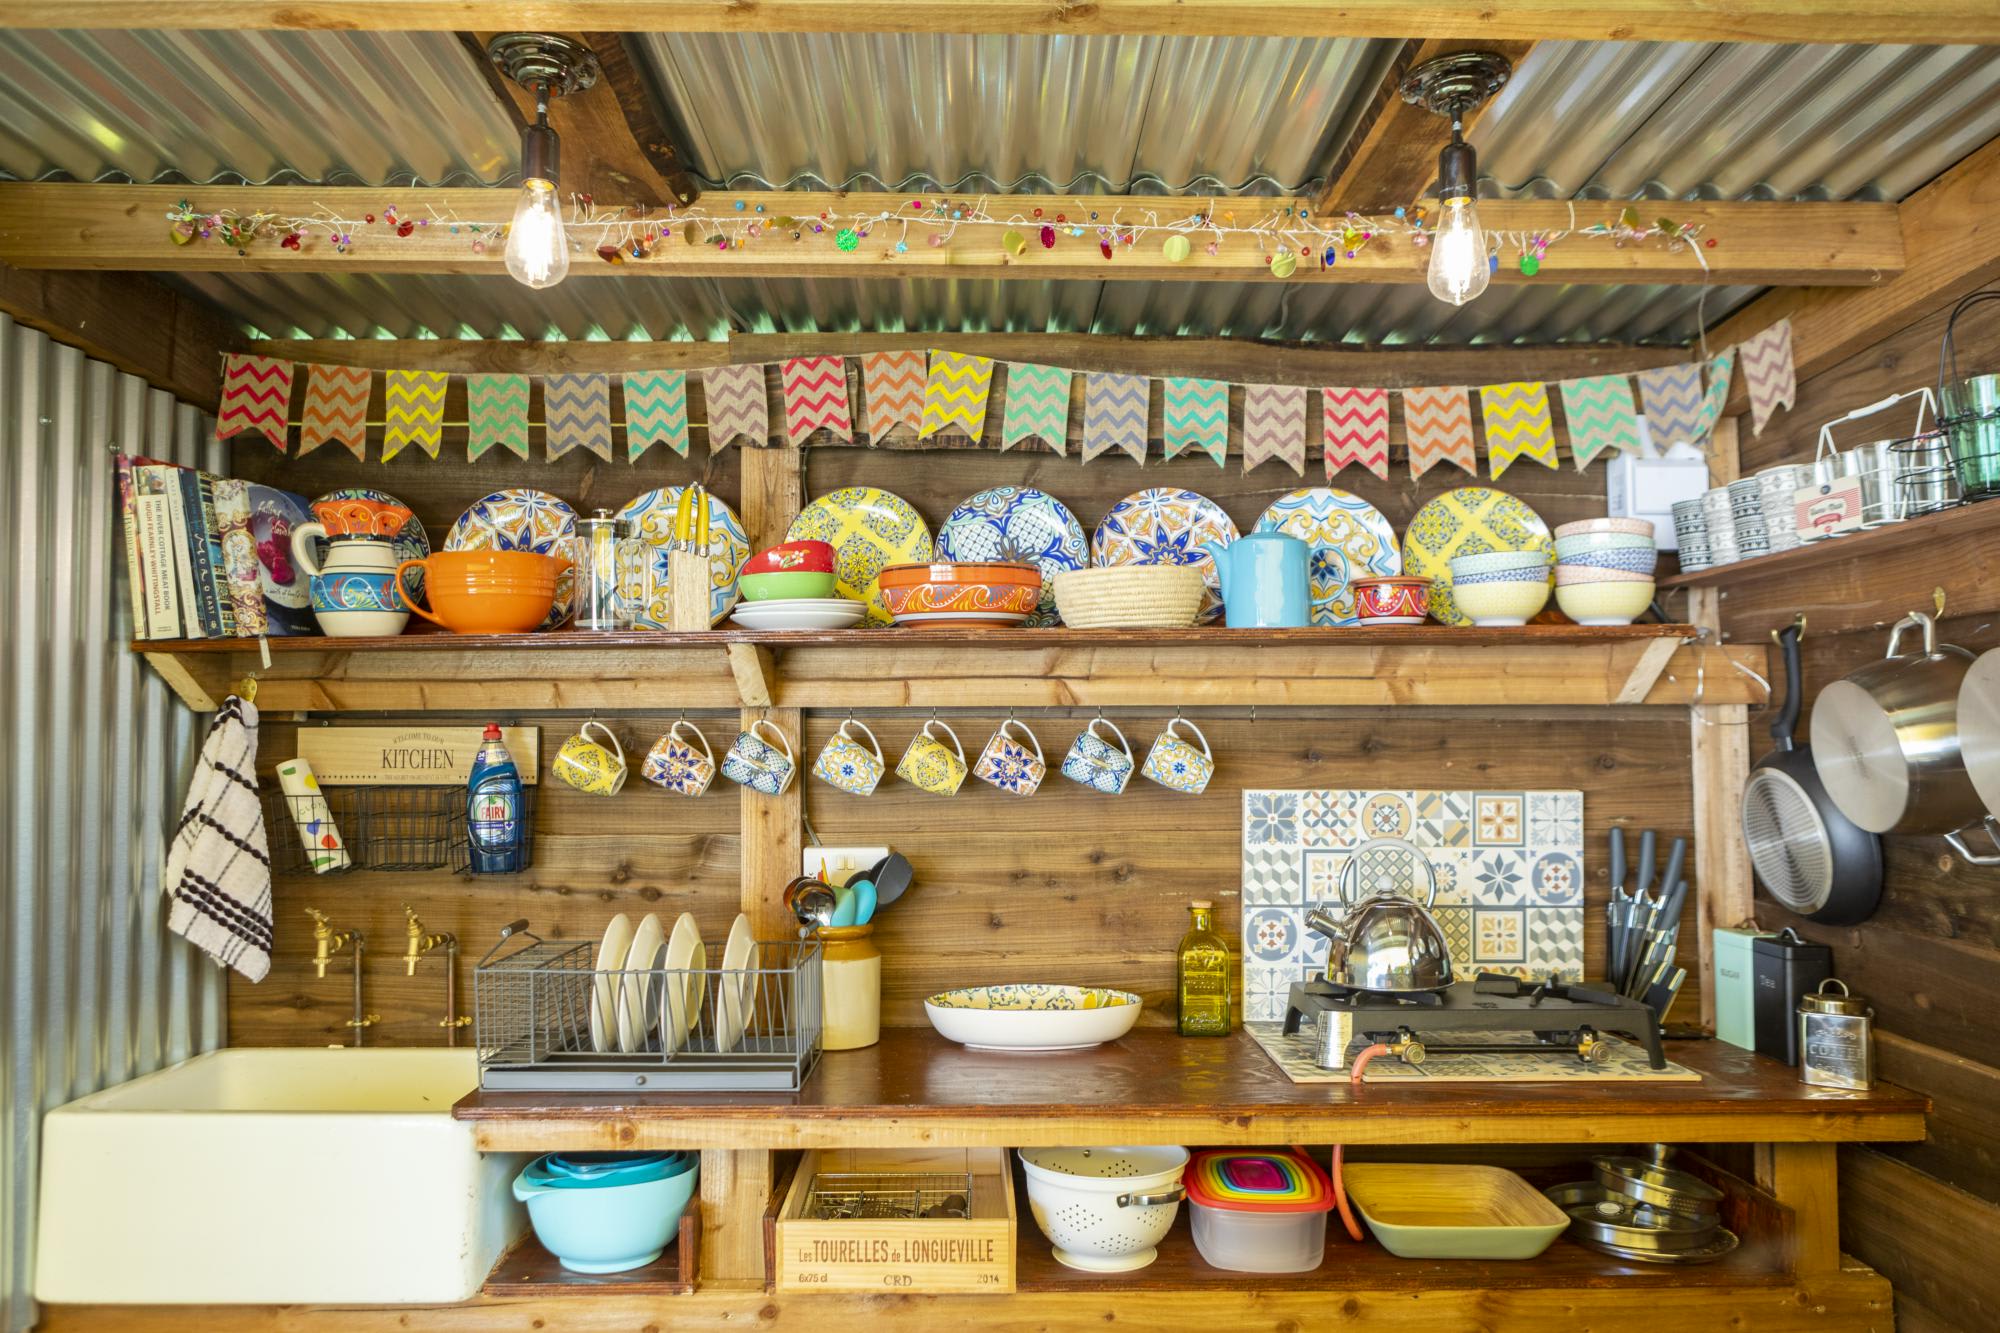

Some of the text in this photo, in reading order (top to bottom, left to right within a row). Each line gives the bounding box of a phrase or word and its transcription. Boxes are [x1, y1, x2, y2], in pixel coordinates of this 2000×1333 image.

[145, 501, 153, 521] HUGH
[156, 514, 164, 534] RIVER
[158, 535, 167, 567] COTTAGE
[161, 569, 169, 590] MEAT
[163, 591, 171, 610] BOOK
[205, 594, 215, 615] EAST
[393, 732, 445, 745] WELCOME TO OUR
[382, 749, 454, 769] KITCHEN
[481, 807, 505, 819] FAIRY
[799, 1239, 994, 1263] Les TOURELLES de LONGUEVILLE
[798, 1273, 819, 1283] 6x75
[883, 1274, 912, 1287] CRD
[976, 1273, 1000, 1285] 2014
